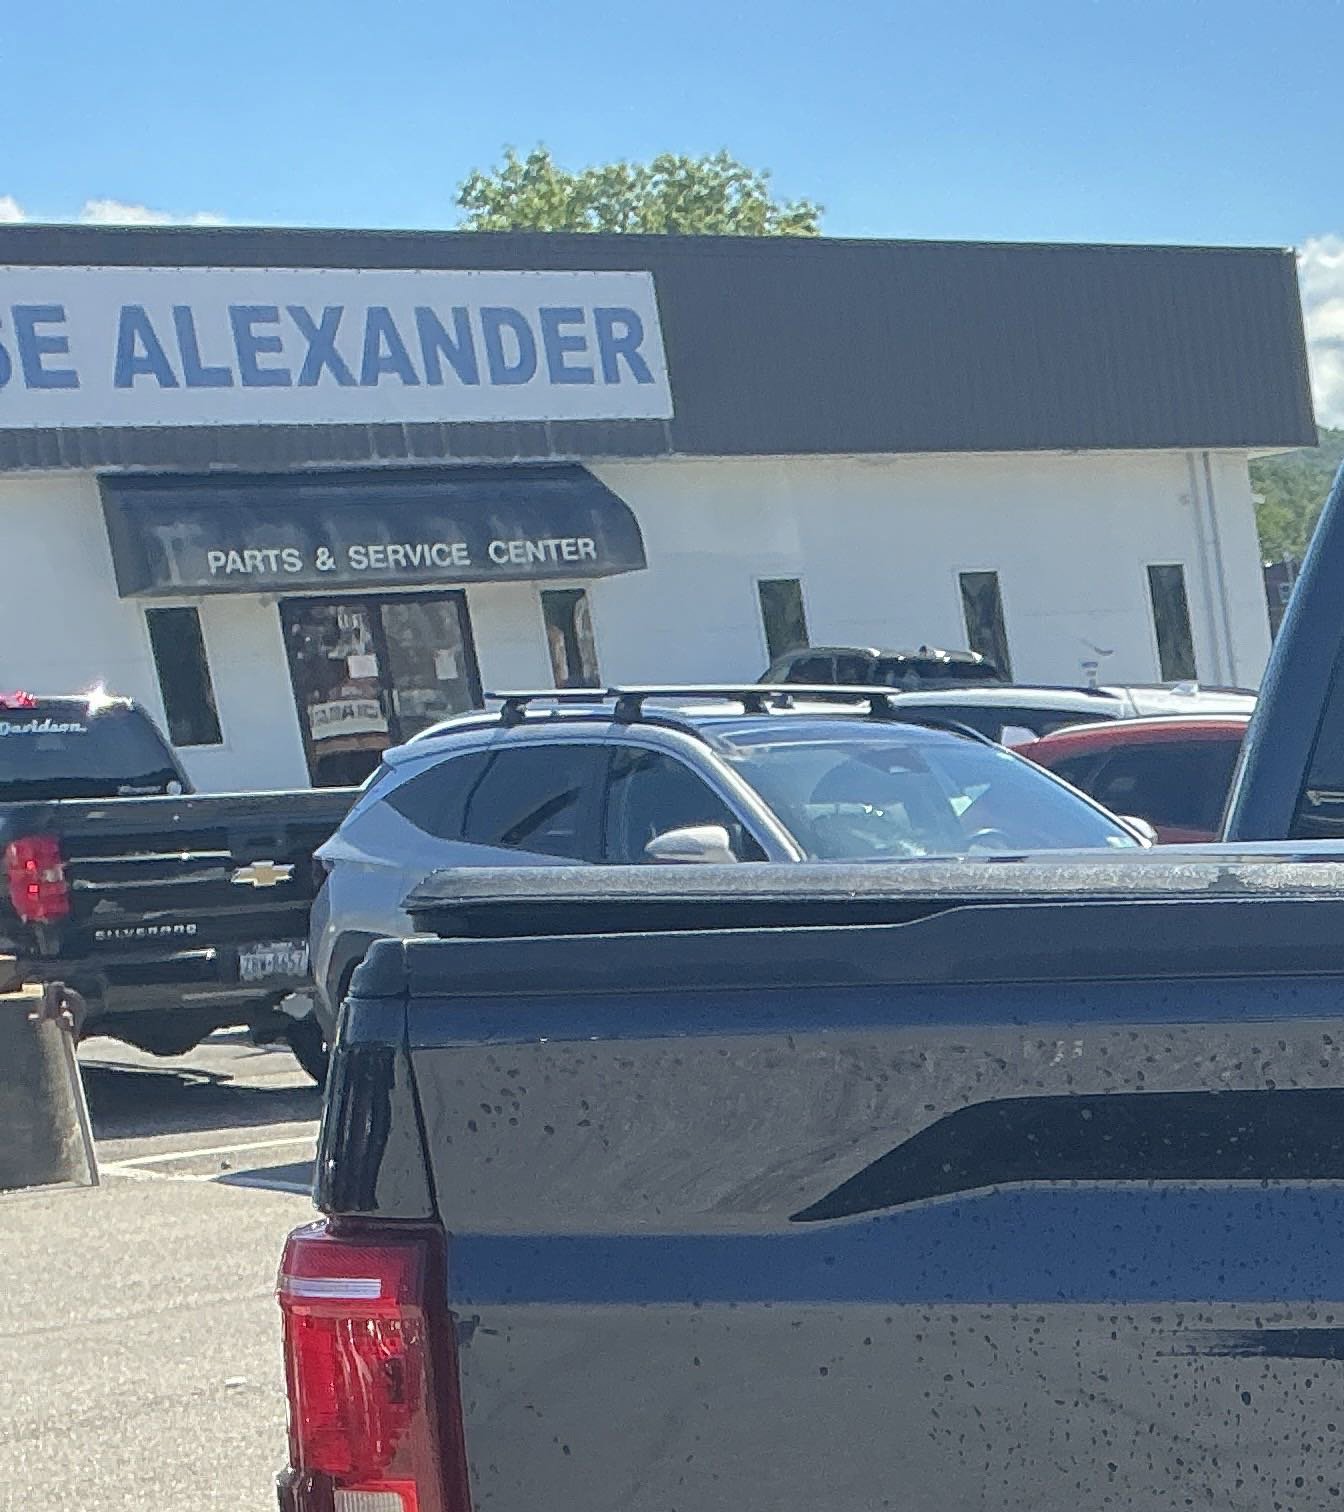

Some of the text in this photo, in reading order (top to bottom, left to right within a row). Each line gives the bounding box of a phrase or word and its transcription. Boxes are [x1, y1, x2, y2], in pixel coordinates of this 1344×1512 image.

[0, 303, 655, 390] E ALEXANDER
[207, 537, 598, 576] PARTS & SERVICE CENTER
[95, 923, 198, 941] SILVERADO
